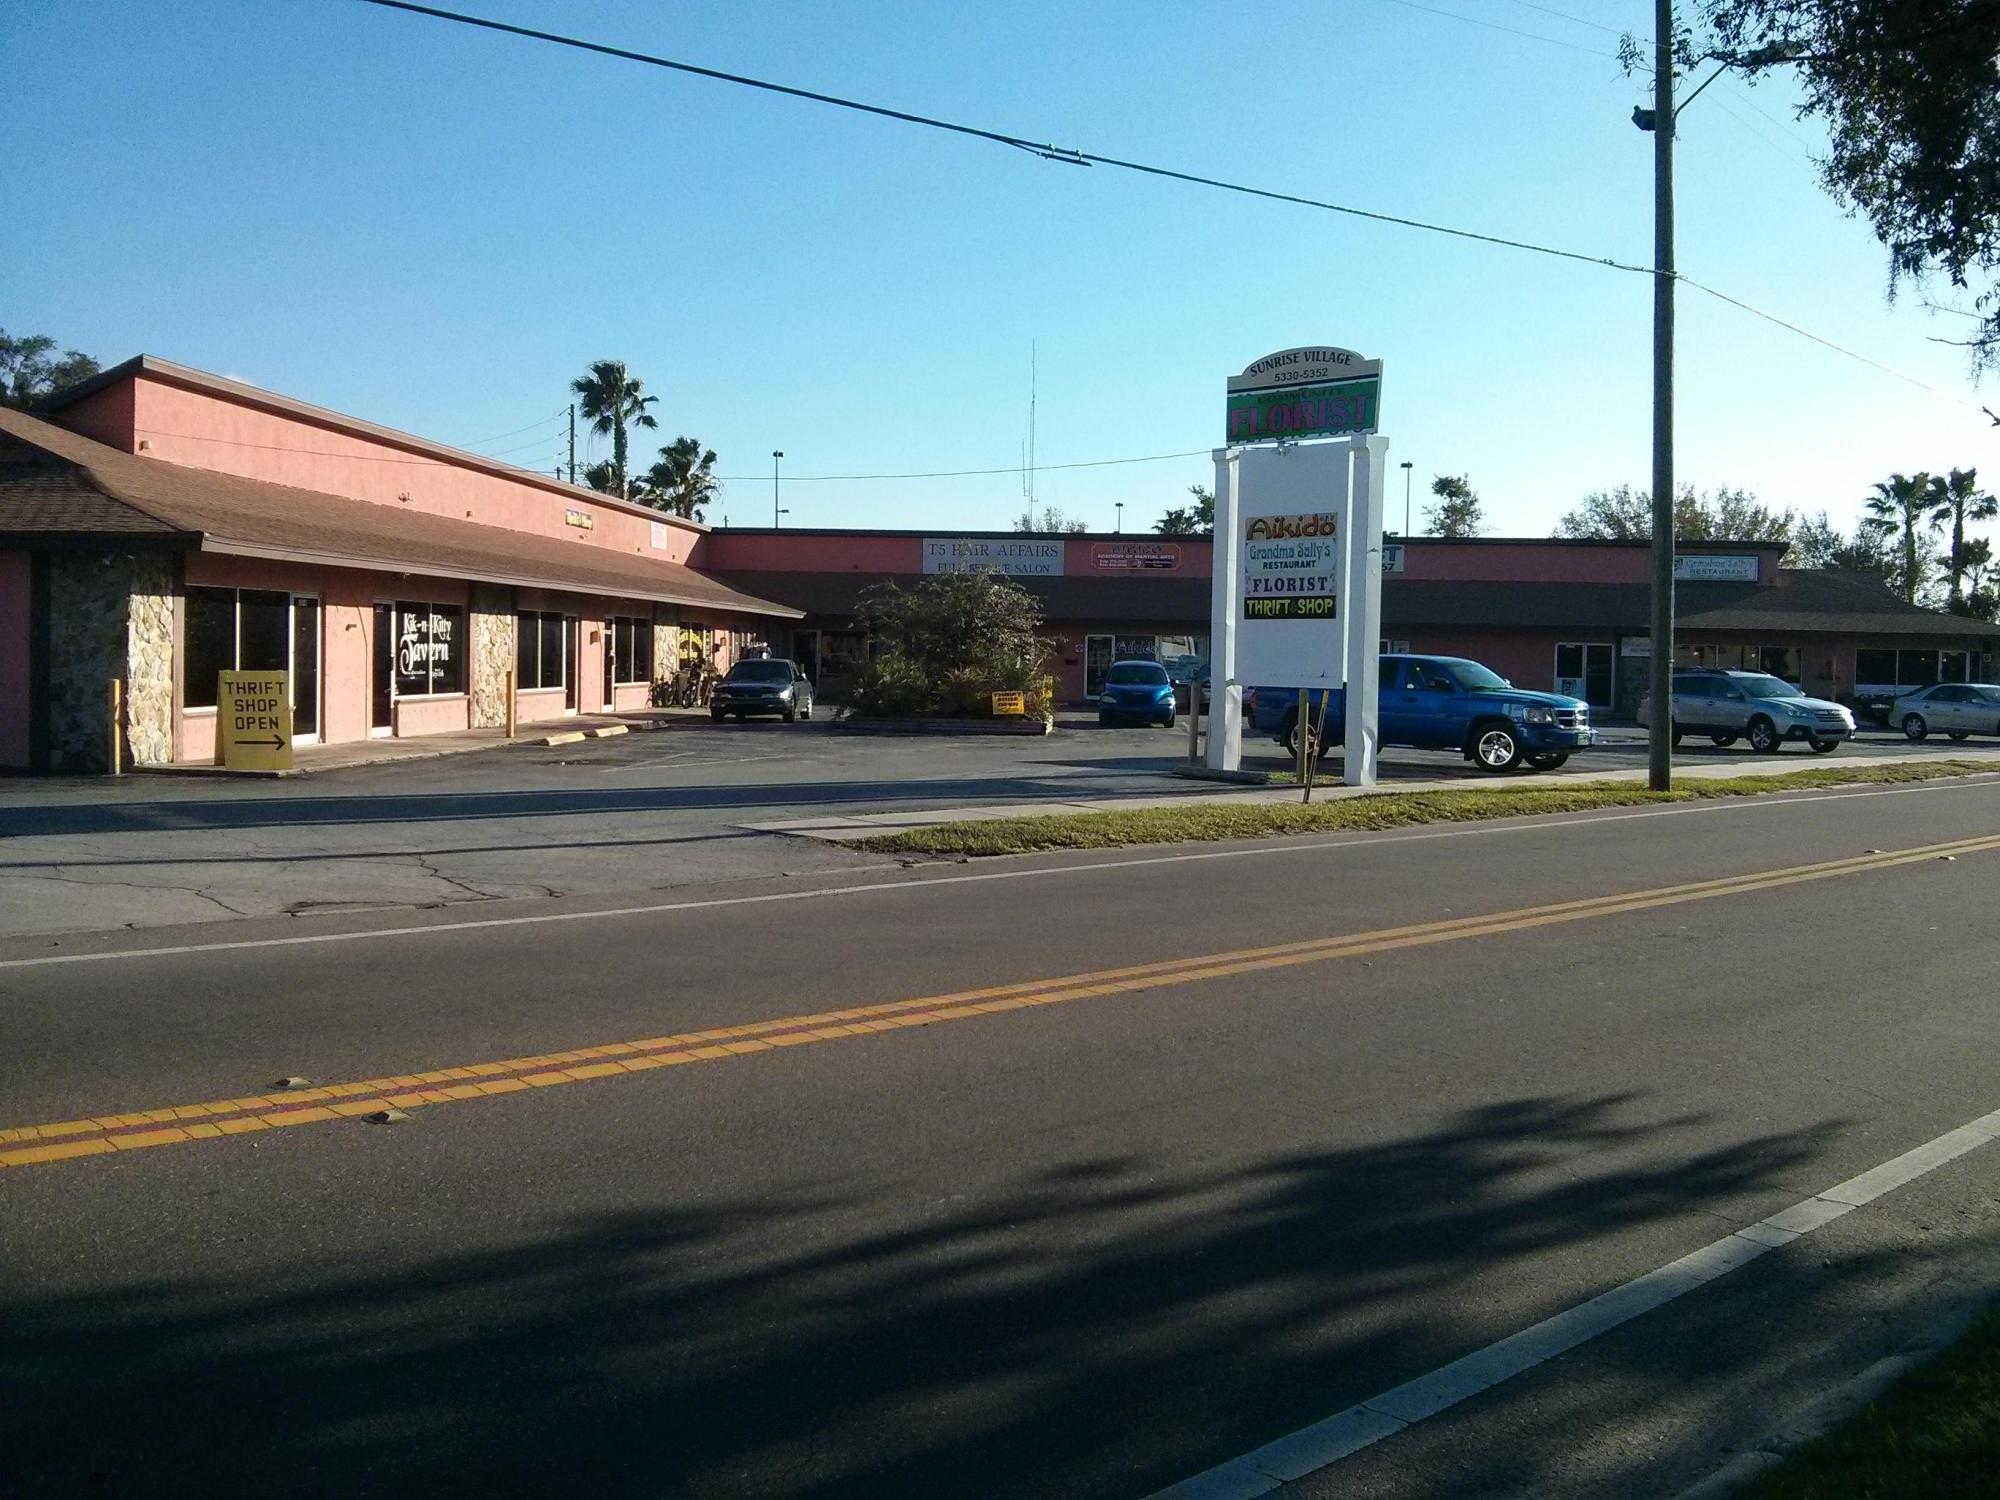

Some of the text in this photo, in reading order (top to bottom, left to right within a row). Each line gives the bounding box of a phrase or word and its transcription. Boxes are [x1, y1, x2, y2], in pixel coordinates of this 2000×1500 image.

[1250, 351, 1354, 377] SUNRISE VILLAGE
[1274, 368, 1329, 382] 5330-5352
[1230, 395, 1369, 437] FLORIST
[1247, 514, 1336, 540] Aikido
[928, 544, 946, 556] T5
[998, 544, 1059, 557] AFFAIRS
[1250, 542, 1331, 560] Grandma Sally's
[1015, 564, 1050, 573] SALON
[1262, 560, 1316, 569] RESTAURANT
[1253, 577, 1328, 592] FLORIST
[1247, 598, 1334, 616] THRIFT SHOP
[400, 633, 449, 675] Tavern
[225, 681, 285, 694] THRIFT
[234, 699, 278, 712] SHOP
[235, 716, 279, 730] OPEN
